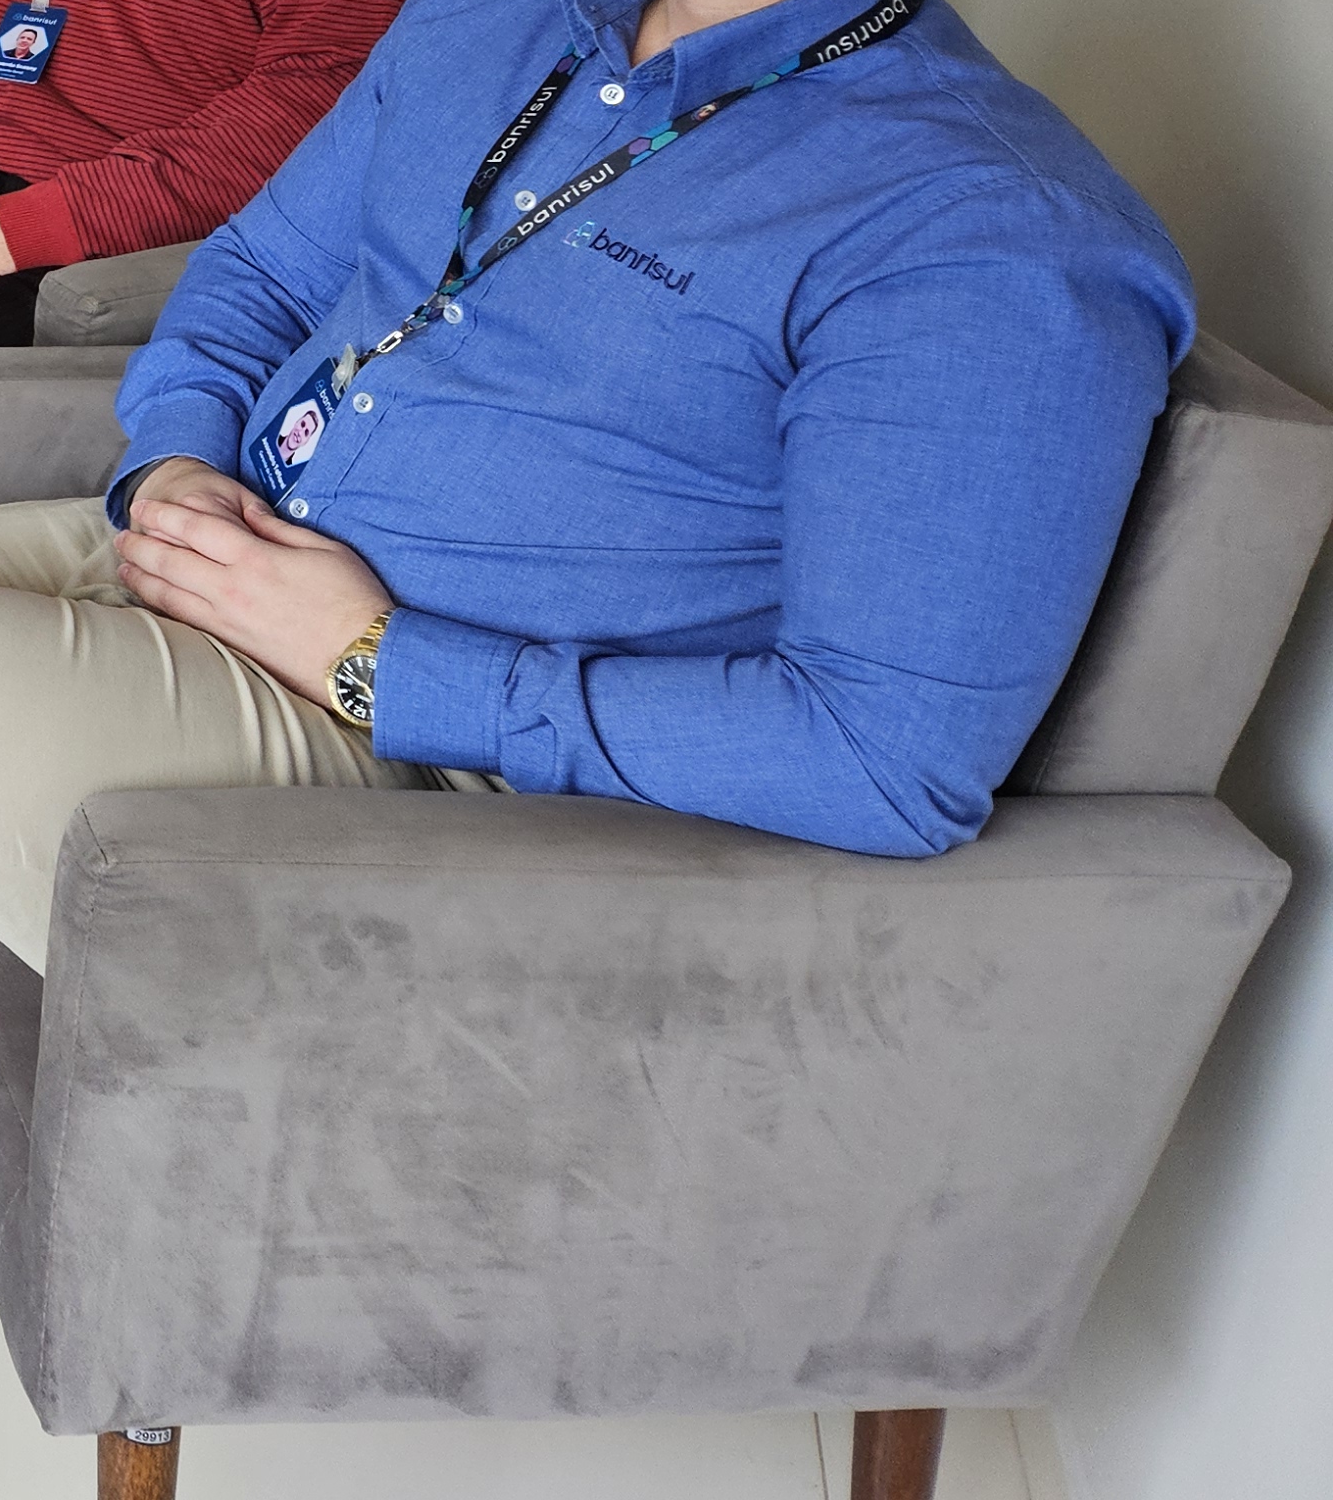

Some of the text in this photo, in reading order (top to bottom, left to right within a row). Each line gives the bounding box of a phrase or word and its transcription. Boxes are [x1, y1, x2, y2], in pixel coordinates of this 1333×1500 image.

[22, 14, 58, 26] banrisul
[487, 86, 558, 163] banrisul
[517, 163, 615, 236] banrisul
[589, 228, 696, 295] banrisul
[135, 1430, 170, 1442] 29913
